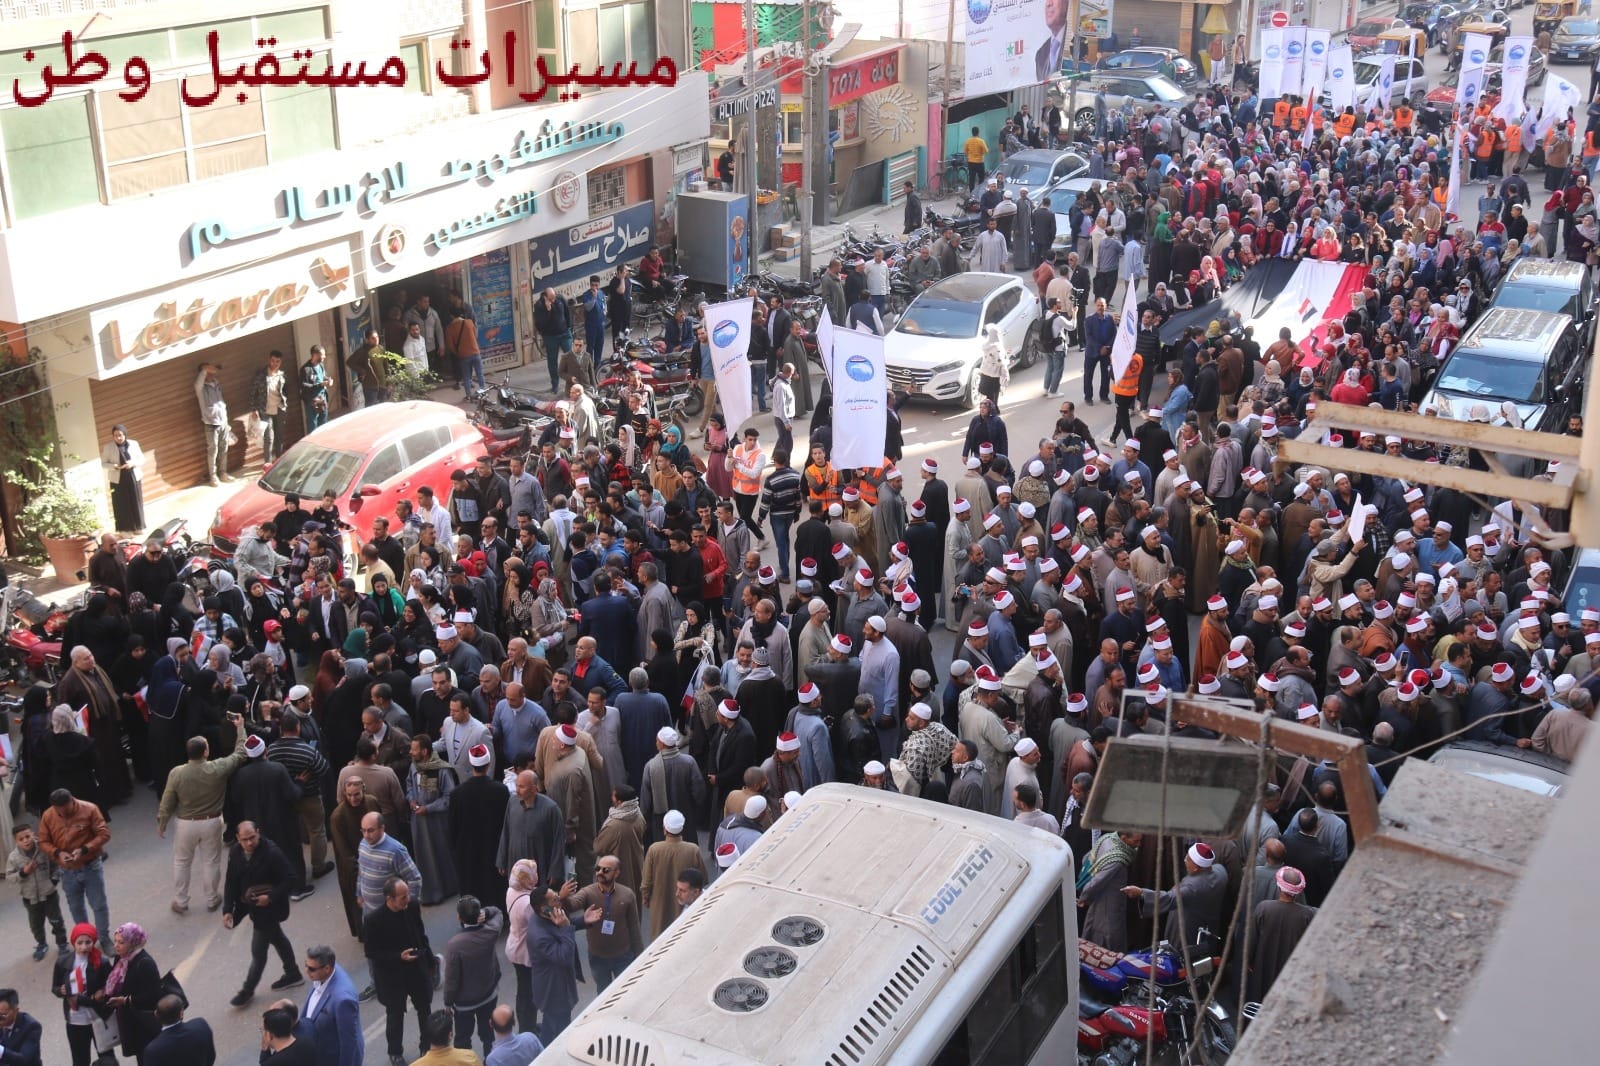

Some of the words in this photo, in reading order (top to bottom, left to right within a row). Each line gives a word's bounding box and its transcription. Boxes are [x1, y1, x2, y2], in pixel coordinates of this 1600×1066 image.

[754, 88, 776, 110] PIZZA
[832, 69, 862, 97] TOTA
[190, 183, 358, 259] سالم
[603, 224, 650, 263] صلاح
[531, 243, 600, 290] سالم
[920, 844, 994, 925] COOLTECH
